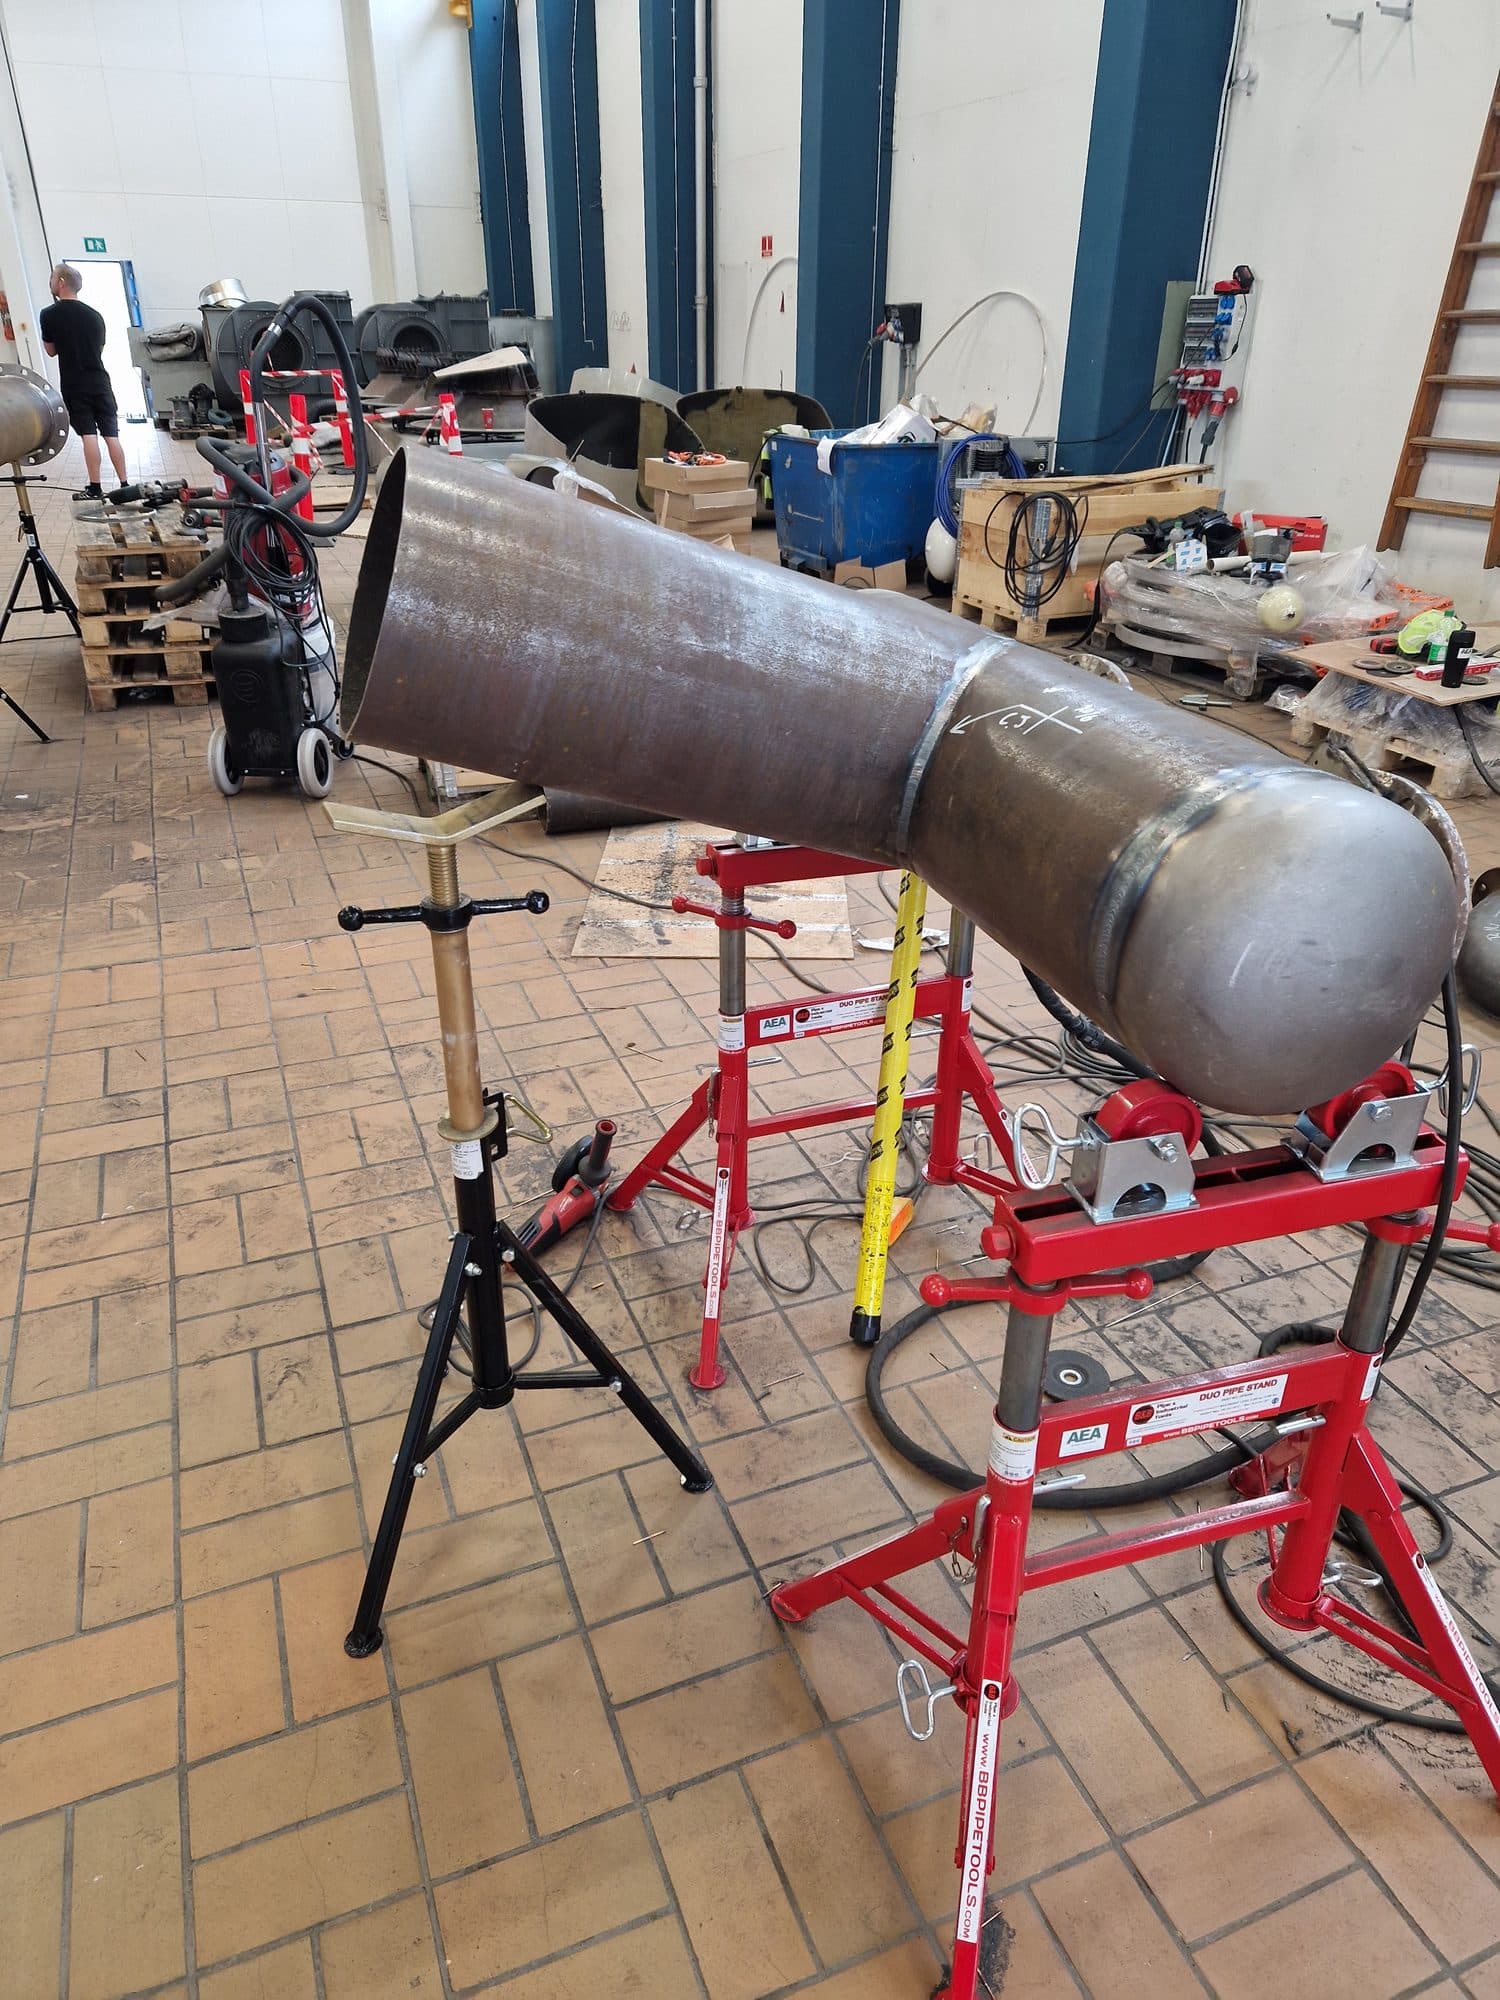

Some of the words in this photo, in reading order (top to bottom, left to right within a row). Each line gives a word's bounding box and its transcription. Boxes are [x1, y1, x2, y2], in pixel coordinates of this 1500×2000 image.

[763, 1017, 786, 1029] AEA
[1199, 1390, 1221, 1401] DUO
[1222, 1384, 1244, 1397] PIPE
[1246, 1378, 1278, 1392] STAND
[1067, 1427, 1101, 1444] AEA
